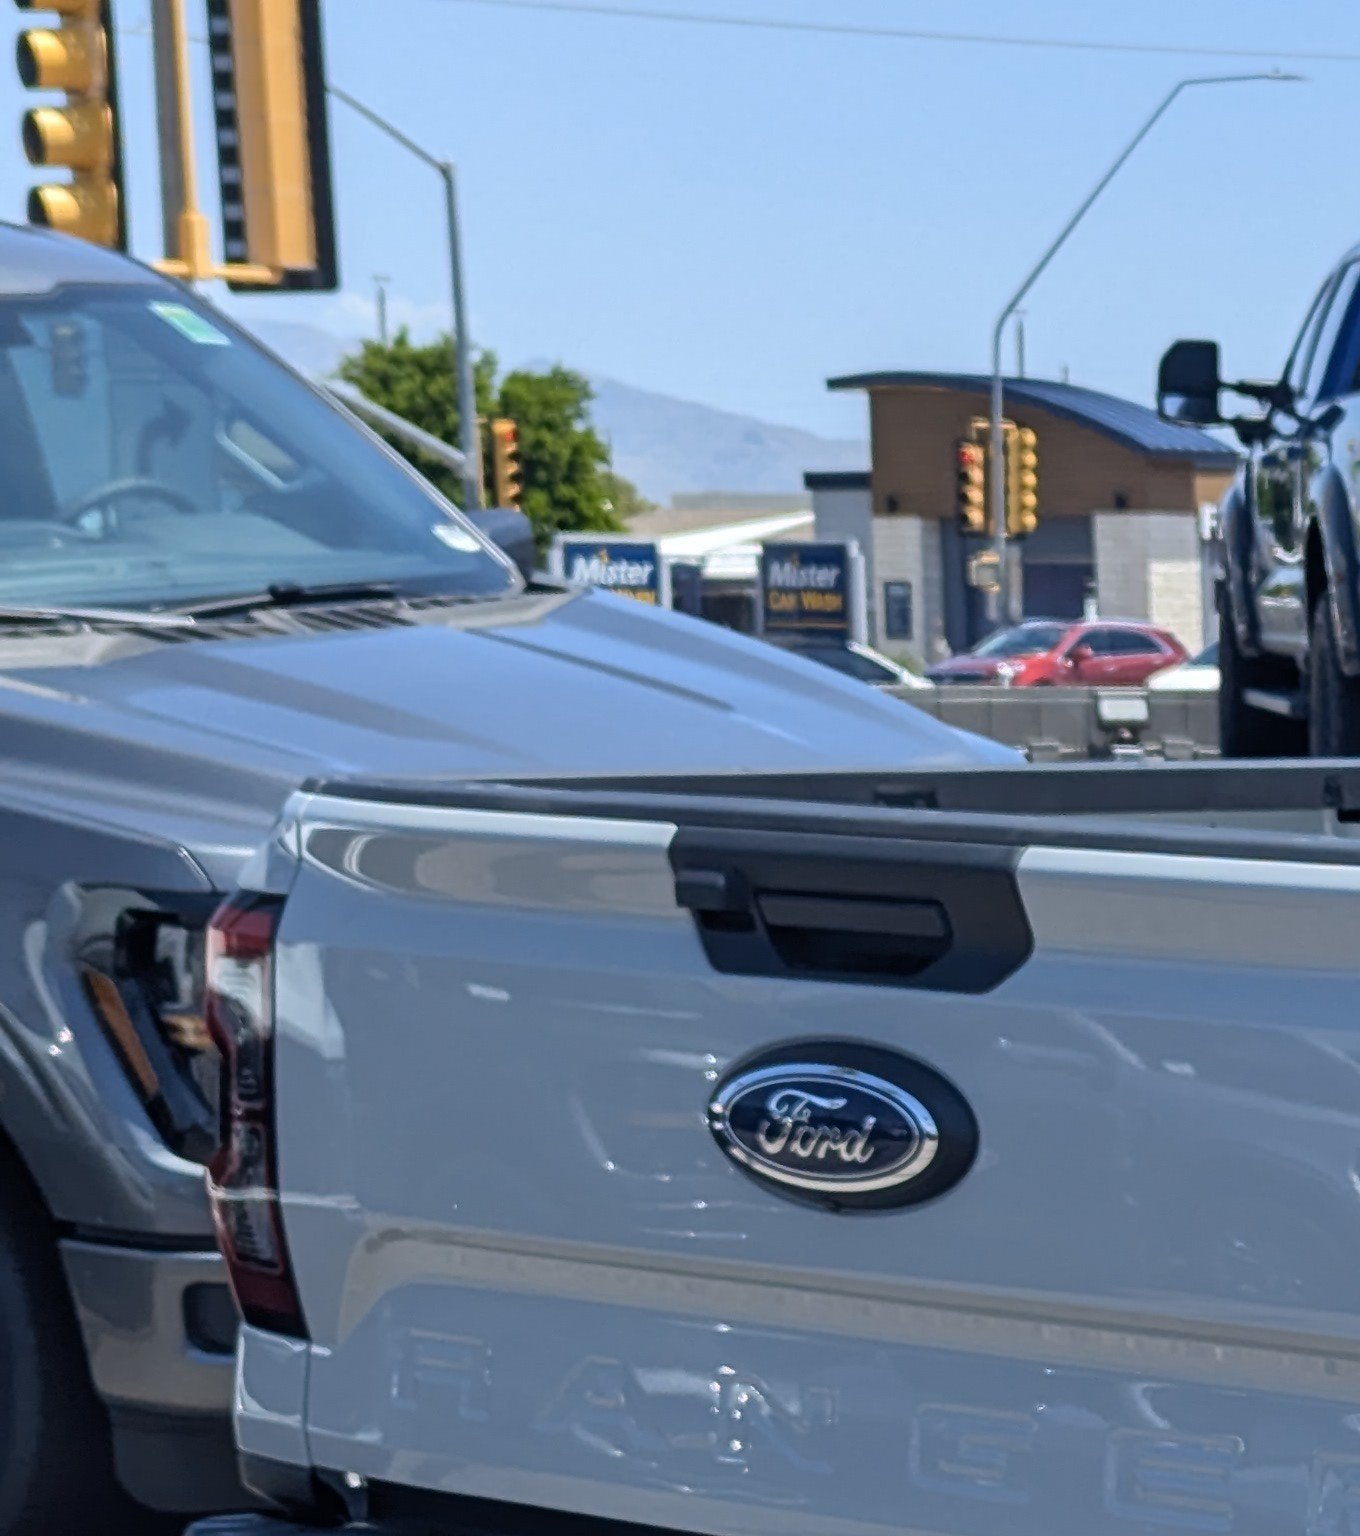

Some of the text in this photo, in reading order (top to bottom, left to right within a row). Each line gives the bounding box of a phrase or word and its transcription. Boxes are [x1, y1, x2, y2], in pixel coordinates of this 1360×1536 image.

[572, 555, 655, 587] Mister
[769, 560, 841, 588] Mister
[756, 1089, 876, 1163] Ford
